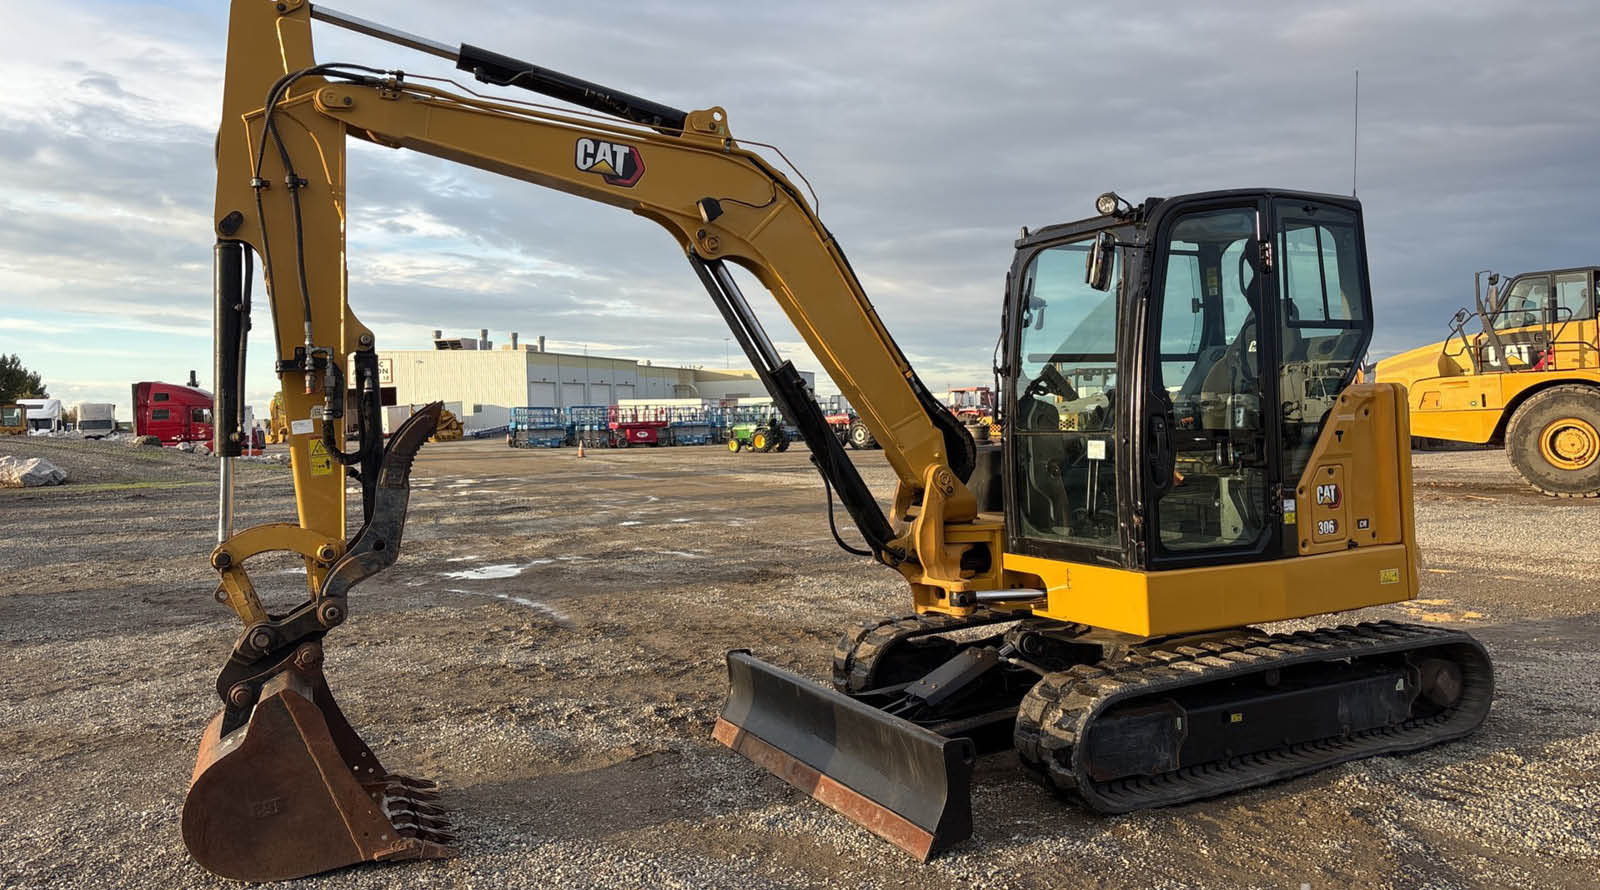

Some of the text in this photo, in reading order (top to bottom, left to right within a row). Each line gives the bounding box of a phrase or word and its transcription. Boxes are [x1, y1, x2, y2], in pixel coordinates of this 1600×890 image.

[576, 138, 630, 177] CAT
[1316, 484, 1337, 505] CAT
[1318, 521, 1335, 535] 306
